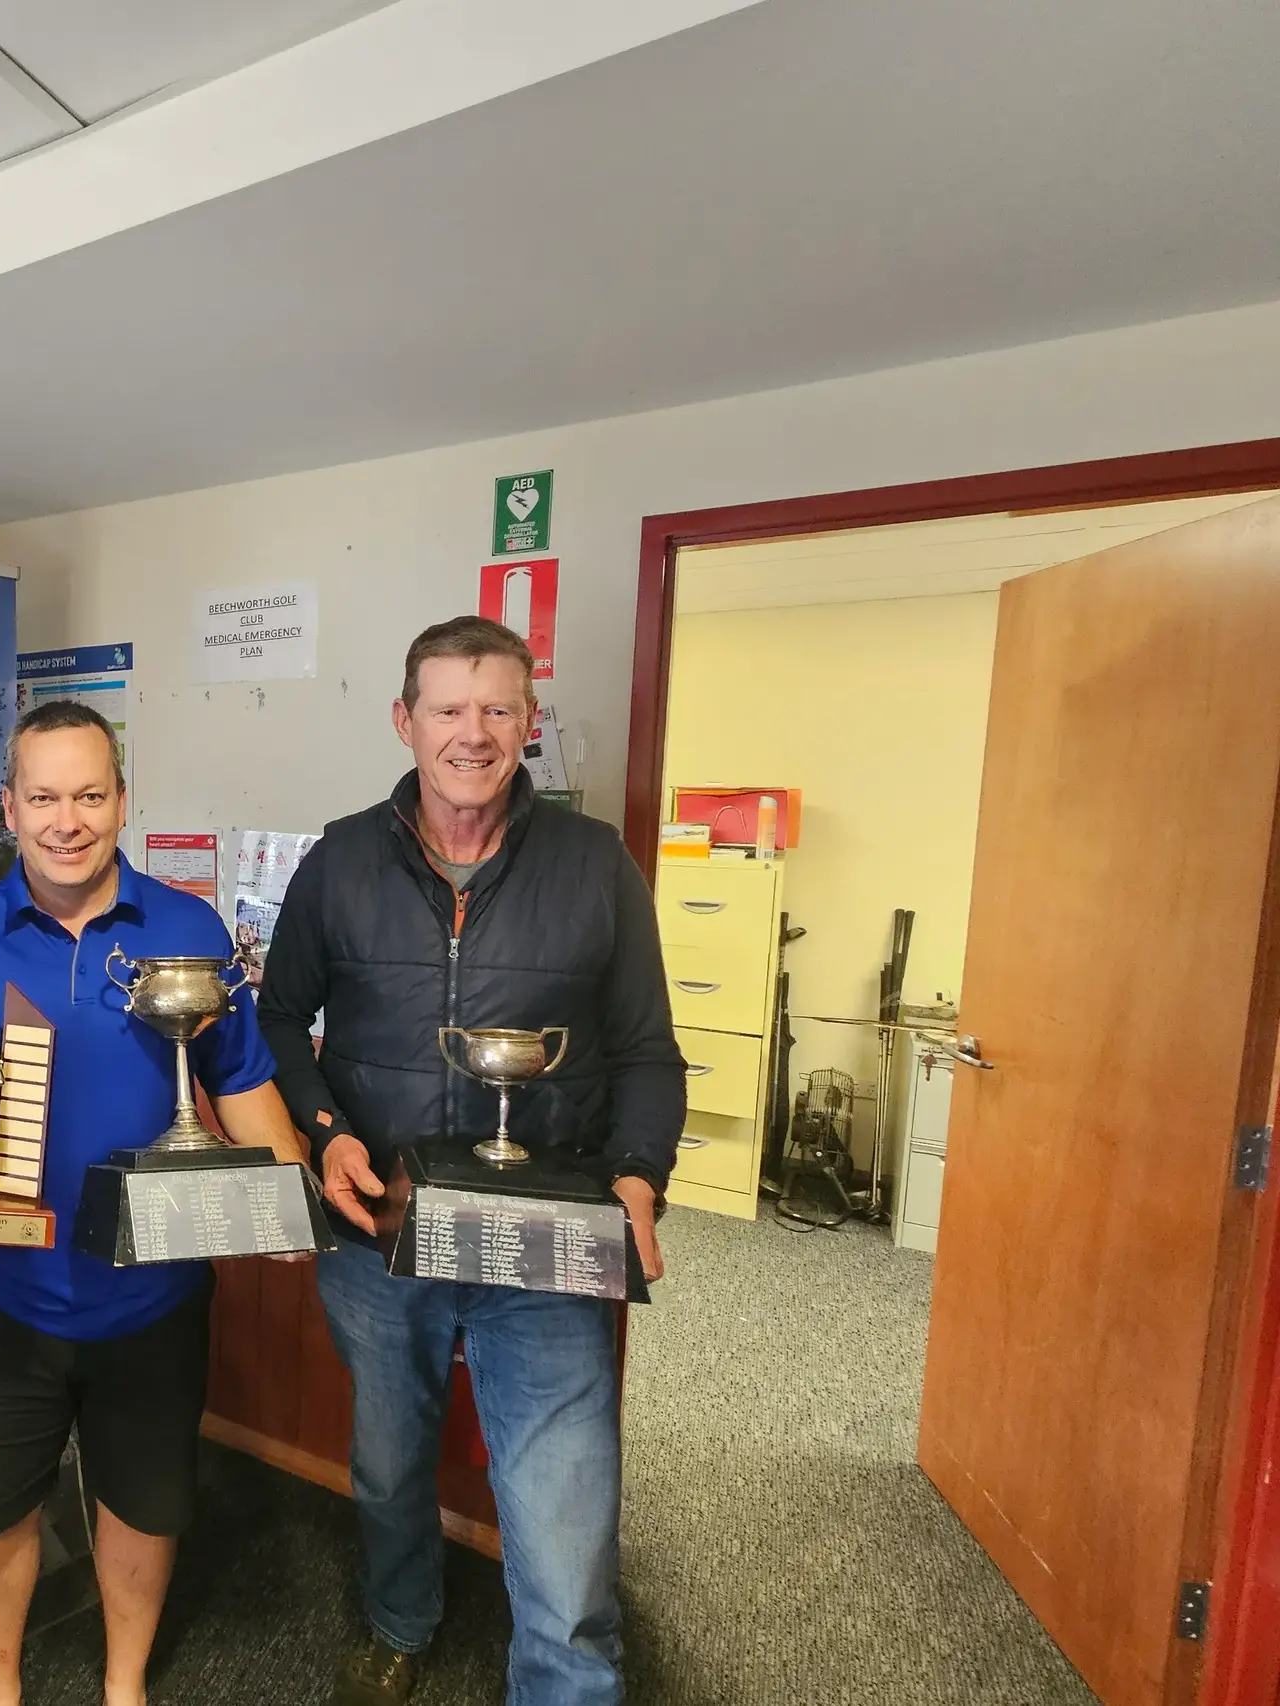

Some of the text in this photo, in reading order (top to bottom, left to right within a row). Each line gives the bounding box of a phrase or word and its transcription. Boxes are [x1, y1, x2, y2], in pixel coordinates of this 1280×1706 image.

[512, 478, 535, 490] AED
[208, 594, 297, 614] BEECHWORTH GOLF
[240, 614, 264, 625] CLUB
[204, 626, 302, 645] MEDICAL EMERGENCY
[240, 646, 263, 656] PLAN
[22, 658, 52, 671] HANDICAP
[52, 655, 76, 668] SYSTEM
